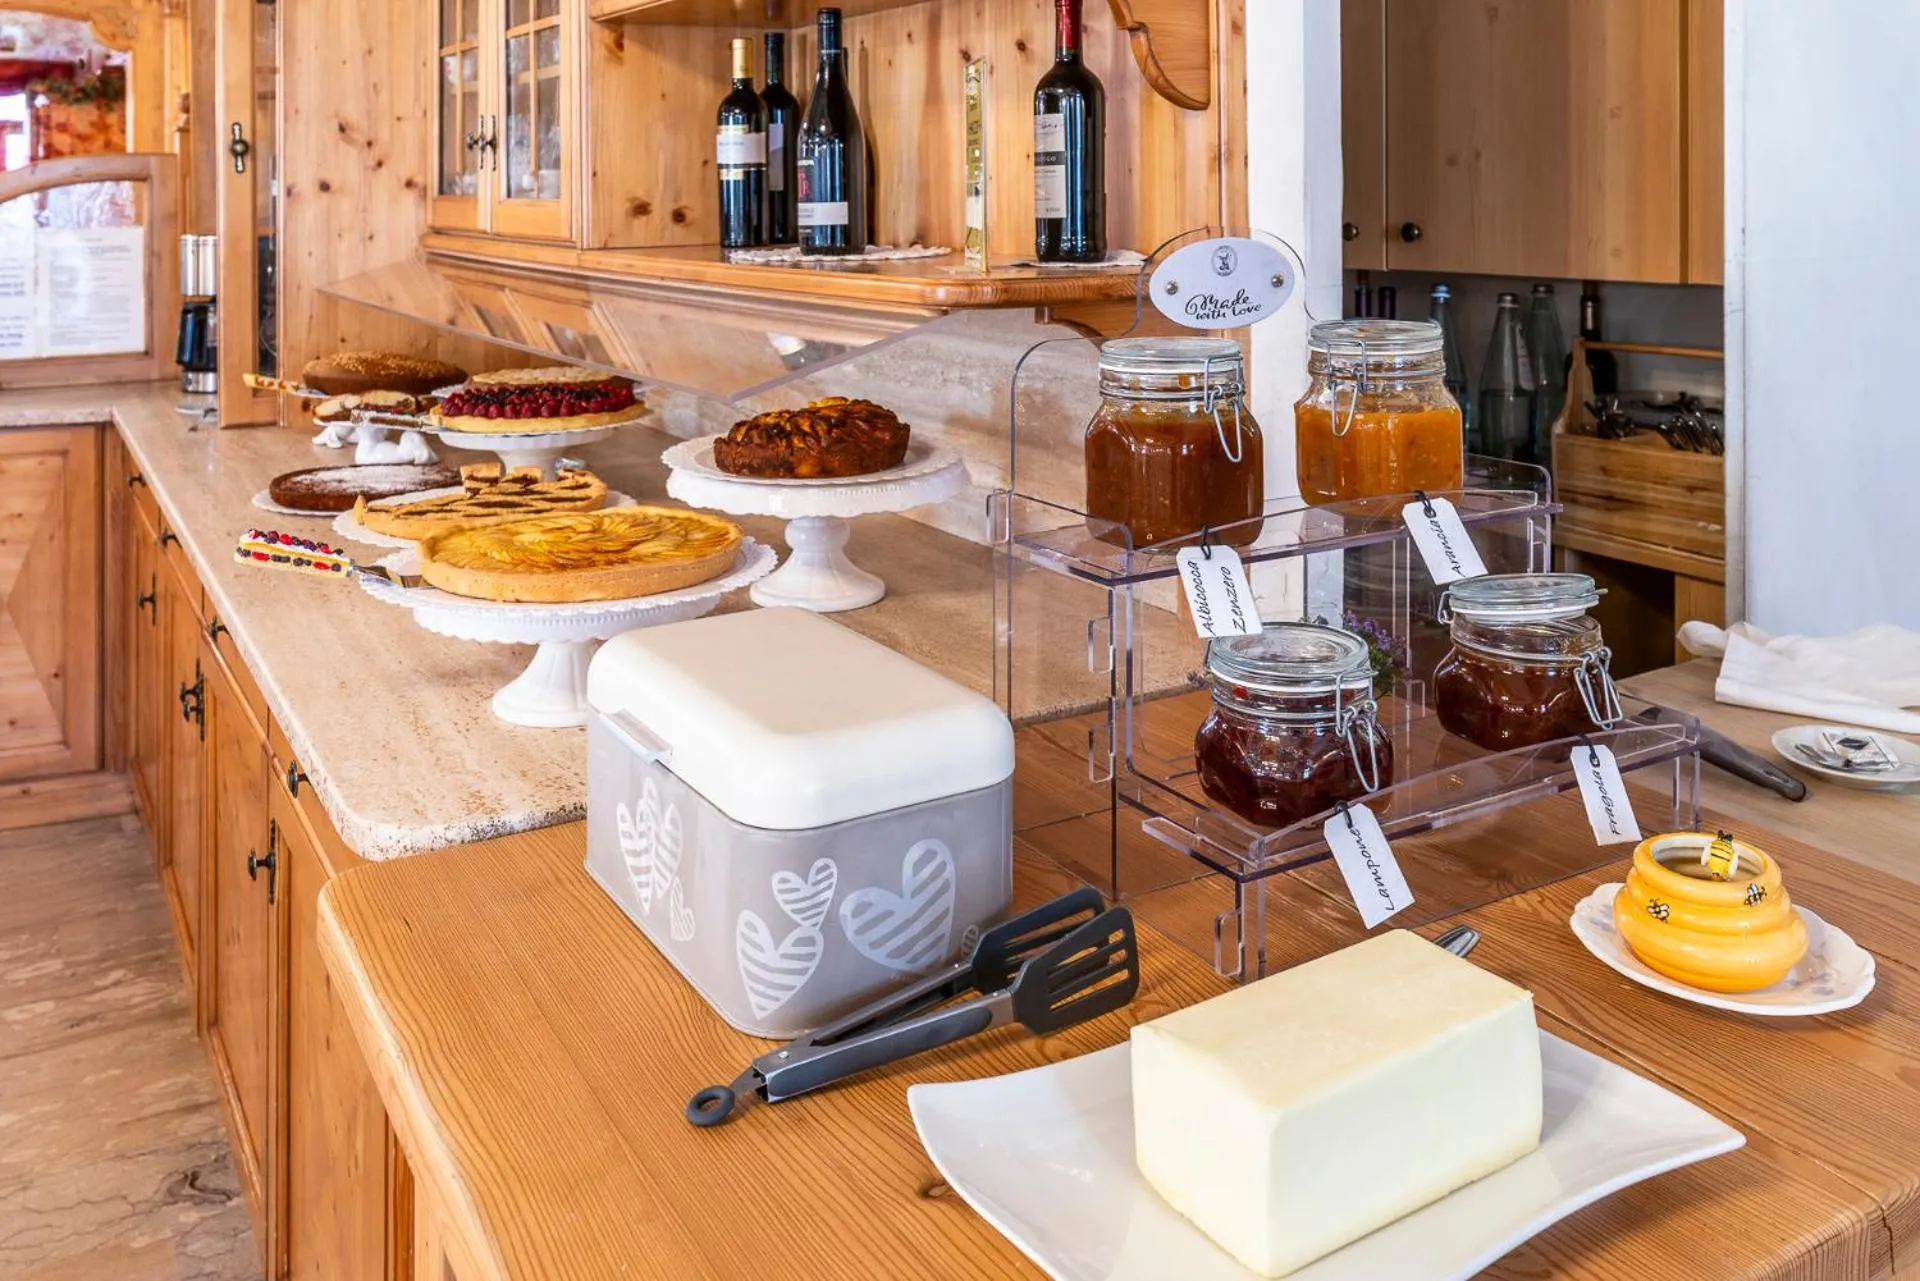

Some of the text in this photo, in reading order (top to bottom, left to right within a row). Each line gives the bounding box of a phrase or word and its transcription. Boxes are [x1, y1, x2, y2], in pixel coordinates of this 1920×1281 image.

[1184, 289, 1250, 315] Made
[1196, 307, 1226, 320] with
[1430, 519, 1466, 577] Arancia
[1187, 560, 1217, 636] Albicocca
[1220, 566, 1247, 634] Zenzero
[1592, 770, 1622, 835] Fragola
[1350, 829, 1395, 911] Lampone
